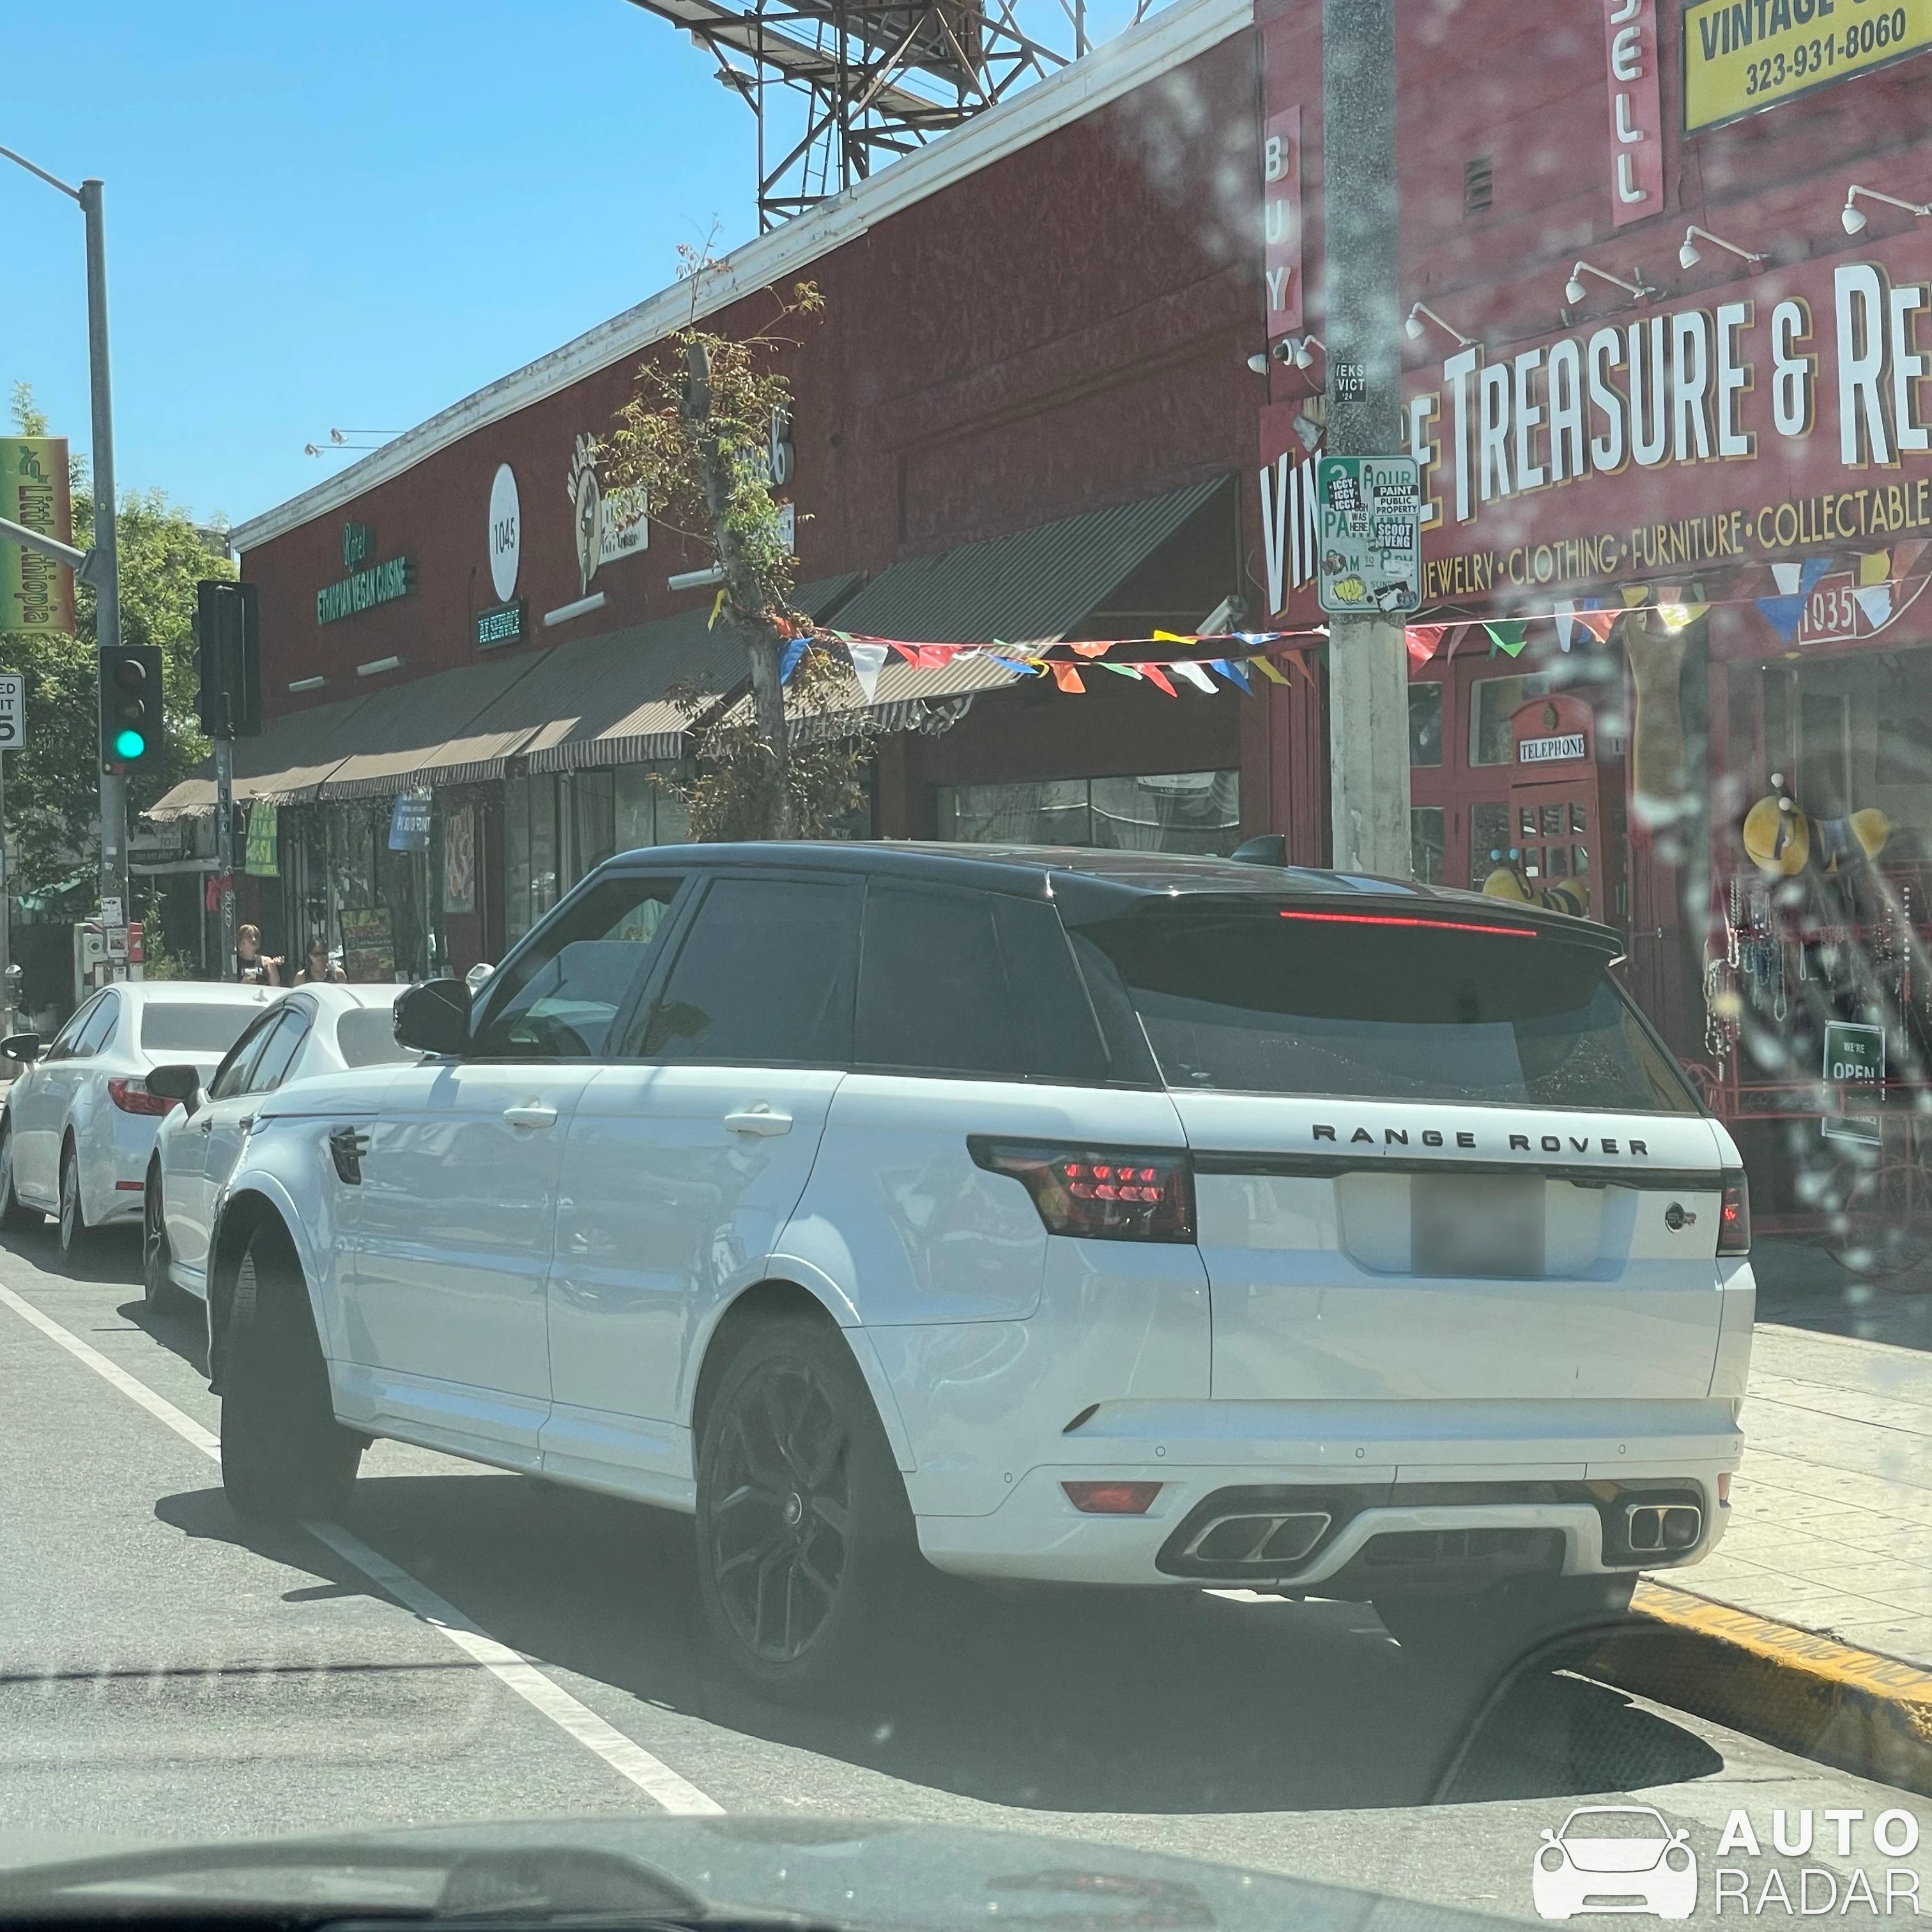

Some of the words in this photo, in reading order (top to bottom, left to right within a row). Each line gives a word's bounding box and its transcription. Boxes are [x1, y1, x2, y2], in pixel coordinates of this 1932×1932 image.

[1746, 8, 1906, 95] 323-931-8060
[1266, 135, 1291, 311] BUY
[1260, 397, 1434, 616] VINE
[1444, 303, 1747, 522] TREASURE
[1772, 302, 1808, 436] &
[1834, 265, 1932, 464] RE
[1333, 479, 1353, 491] ICCY
[1334, 489, 1354, 500] ICCY
[1380, 486, 1413, 496] PAINT
[19, 486, 55, 535] Little
[1335, 499, 1356, 510] ICCY
[1376, 505, 1417, 514] PROPERTY
[1381, 497, 1412, 505] PUBLIC
[1349, 523, 1368, 532] HERE
[1351, 512, 1367, 521] WAS
[494, 517, 516, 555] 1045
[1378, 524, 1411, 535] SCOOT
[1422, 551, 1494, 599] JEWELRY
[1508, 535, 1618, 586] CLOTHING
[1631, 510, 1744, 569] FURNITURE
[1758, 479, 1931, 549] COLLECTABLE
[14, 546, 58, 624] thiopia
[351, 568, 376, 612] VEGAN
[376, 556, 406, 603] CUISINE
[1804, 585, 1852, 633] 1035
[0, 715, 15, 740] 5
[1521, 738, 1584, 760] TELEPHONE
[1844, 1042, 1865, 1054] WE'RE
[1834, 1062, 1875, 1084] OPEN
[1312, 1124, 1476, 1148] RANGE
[1509, 1134, 1648, 1155] ROVER
